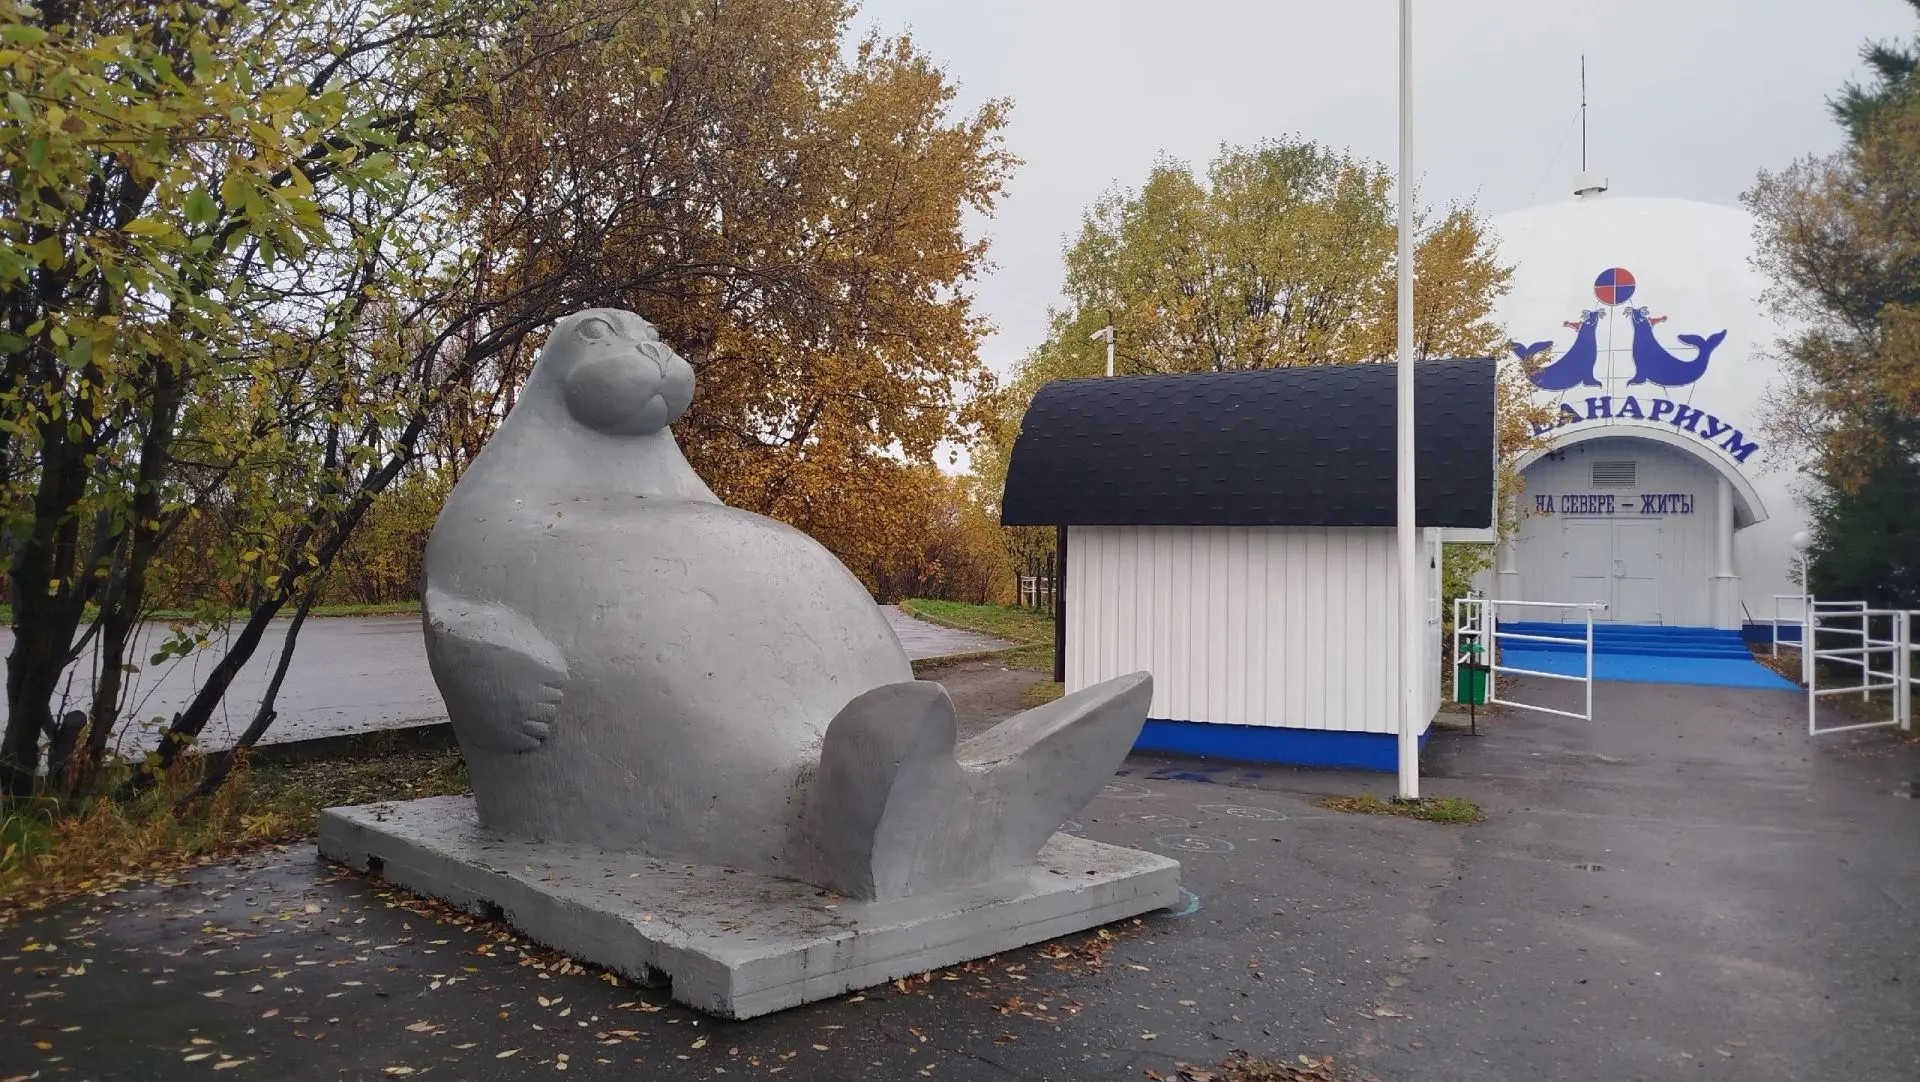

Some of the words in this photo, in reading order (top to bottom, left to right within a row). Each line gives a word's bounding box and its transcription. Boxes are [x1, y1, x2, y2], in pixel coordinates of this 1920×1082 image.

[1535, 494, 1556, 513] НА
[1561, 494, 1615, 514] СЕВЕРЕ
[1640, 494, 1694, 514] ЖИТЬ!
